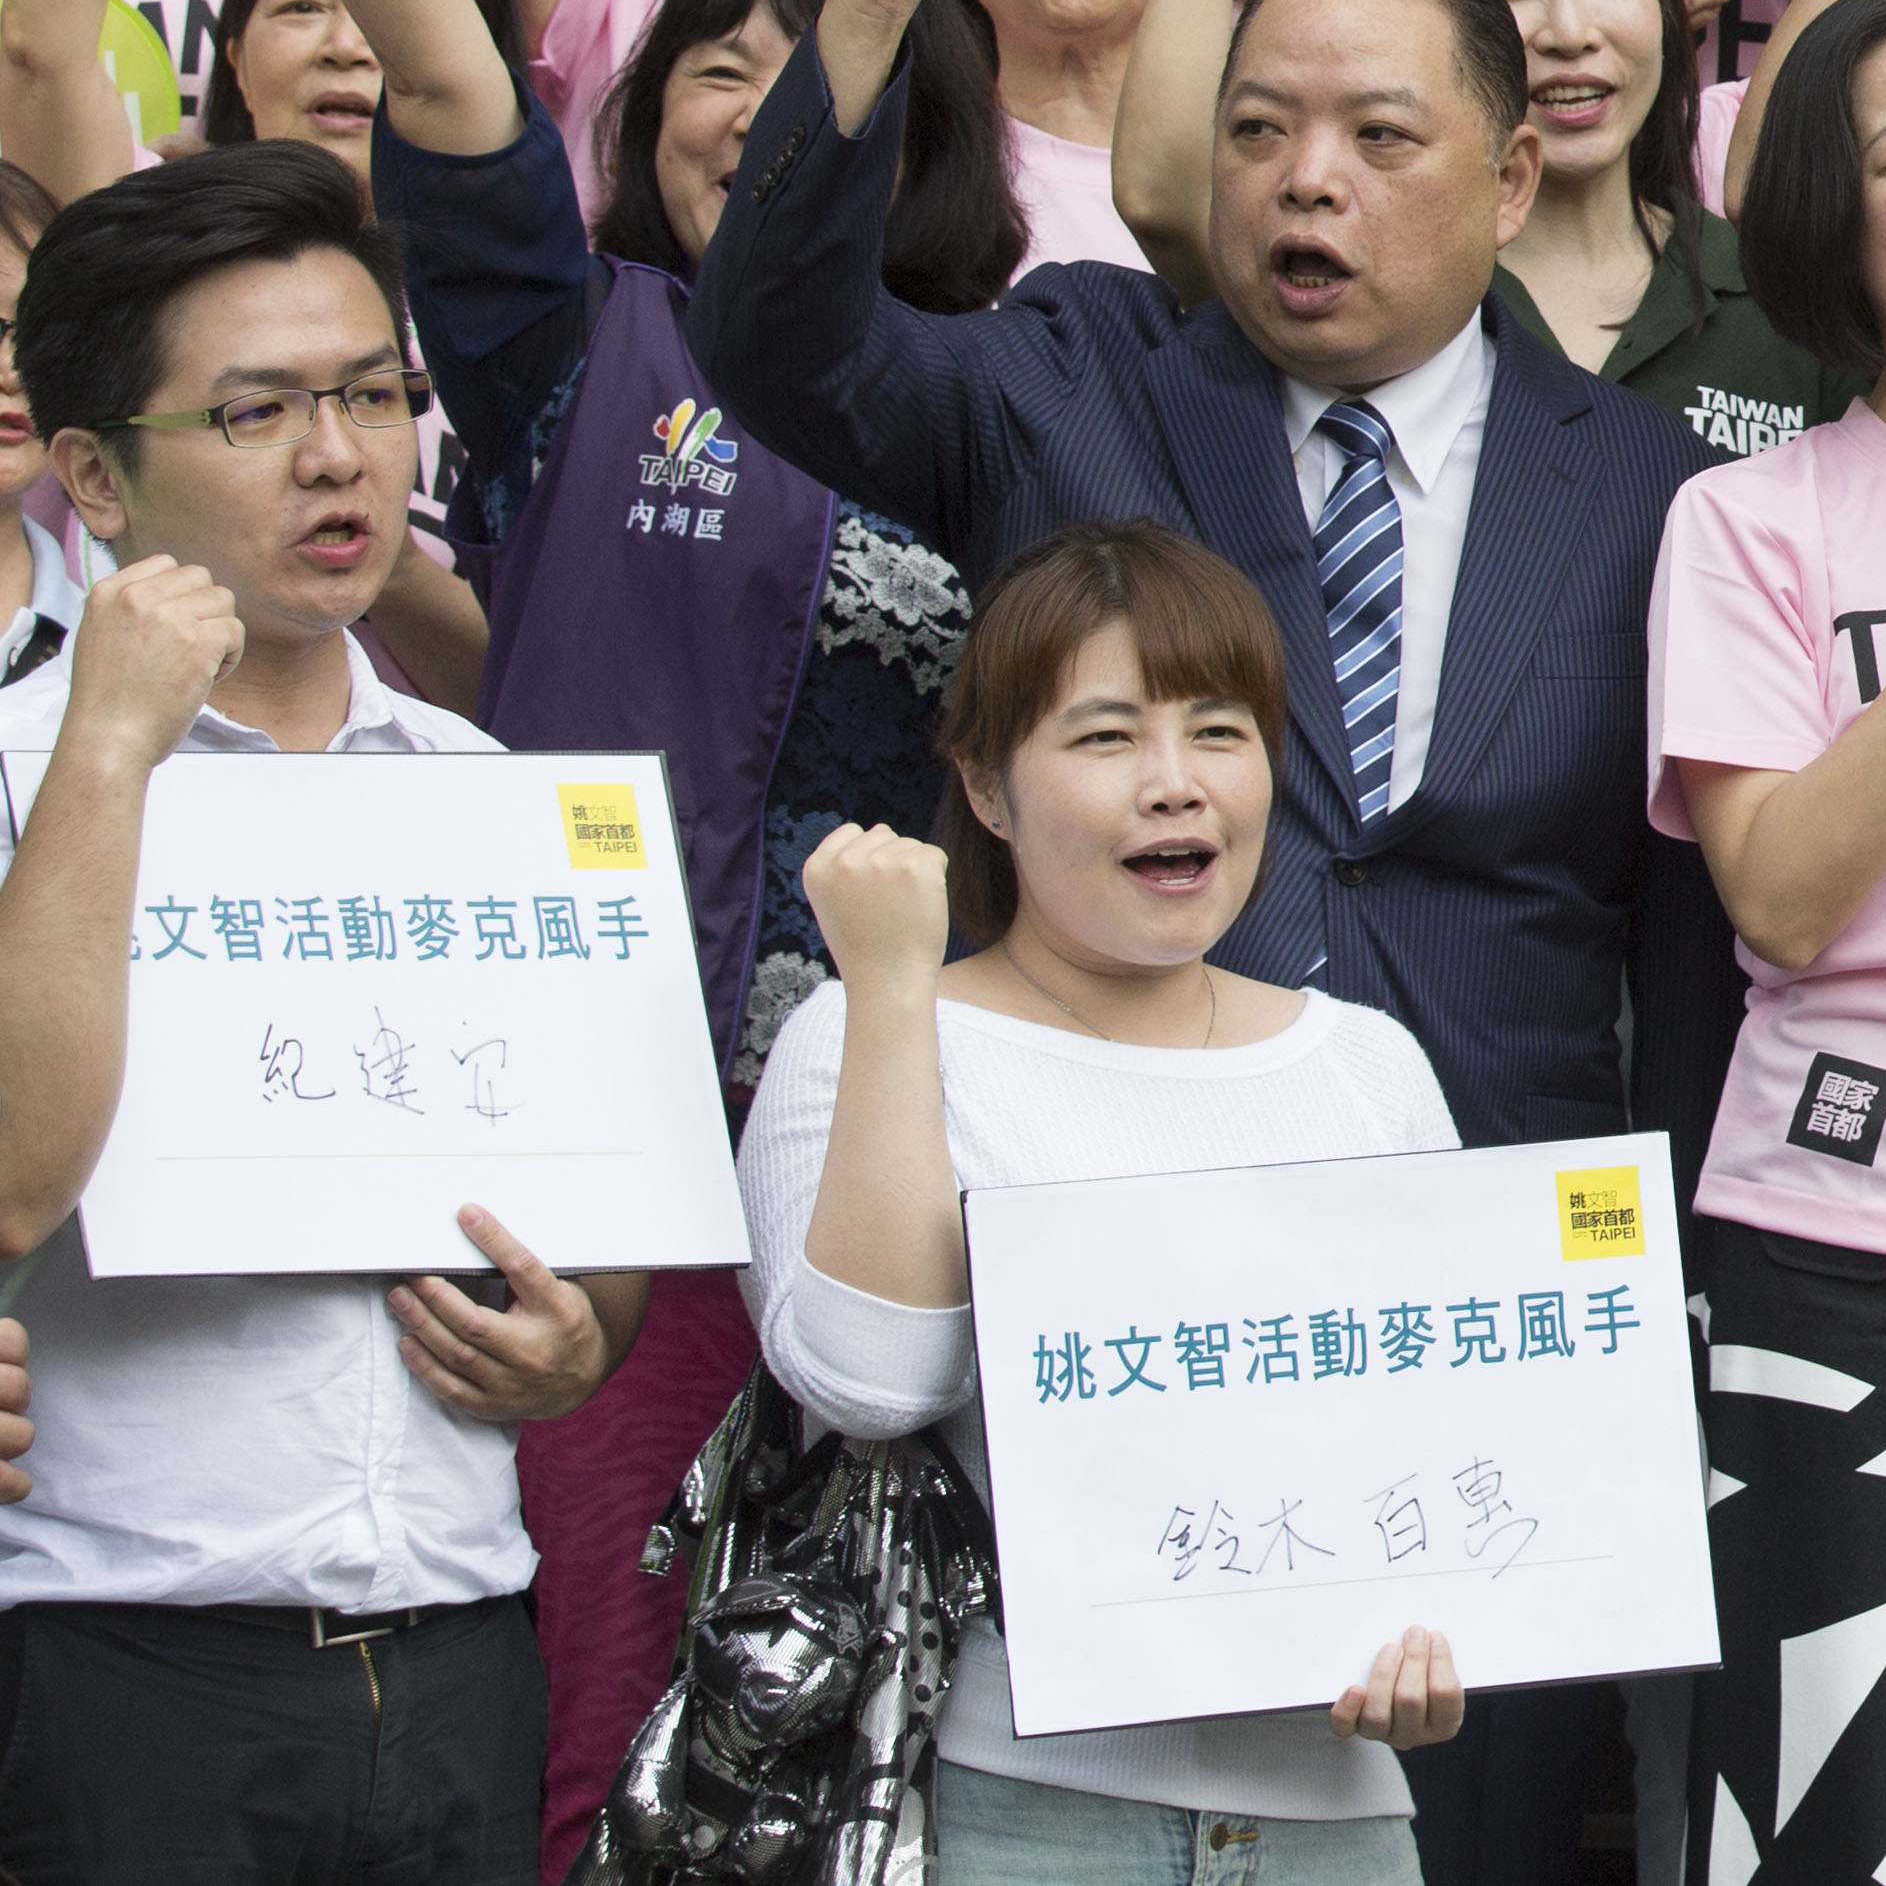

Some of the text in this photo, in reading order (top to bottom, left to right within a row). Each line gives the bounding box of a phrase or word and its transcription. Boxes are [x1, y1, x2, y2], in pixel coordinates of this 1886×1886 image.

[1696, 385, 1804, 430] TAIWAN
[638, 454, 738, 496] TAIPEI
[571, 805, 618, 822] 姚文智
[574, 823, 636, 842] 國家首都
[594, 841, 638, 855] TAIPEI
[1815, 1070, 1880, 1112] 國家
[1806, 1101, 1868, 1143] 首都
[1569, 1189, 1618, 1210] 姚文智
[1570, 1208, 1636, 1231] 國家首都
[1590, 1226, 1637, 1244] TAIPEI
[1032, 1284, 1643, 1406] 姚文智活動麥克風手
